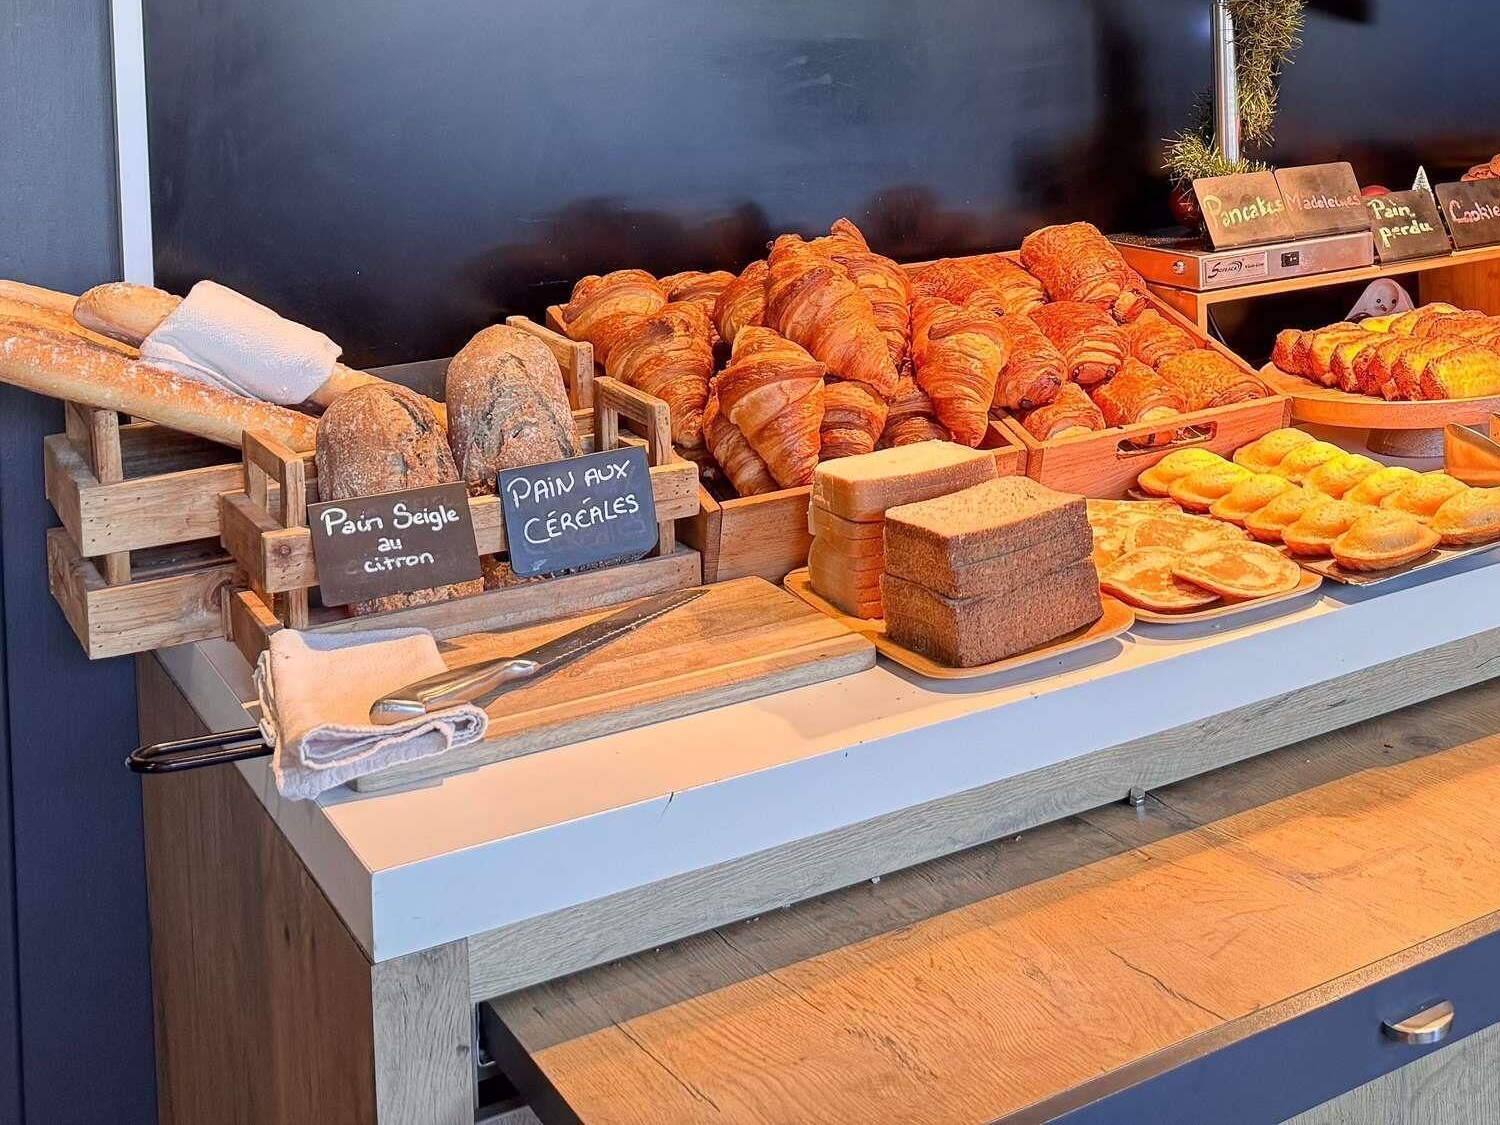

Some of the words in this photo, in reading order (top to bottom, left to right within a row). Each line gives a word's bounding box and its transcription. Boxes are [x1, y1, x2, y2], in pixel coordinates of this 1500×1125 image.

[1202, 194, 1284, 229] Pancakes
[1283, 191, 1361, 211] Madeleines
[1367, 198, 1416, 220] Pain
[1379, 220, 1433, 248] perdu
[584, 459, 632, 484] AUX
[320, 507, 384, 537] Pain
[391, 503, 460, 533] Seigle
[522, 492, 641, 545] CÉRÉALES
[377, 535, 403, 553] au
[363, 550, 435, 574] citron
